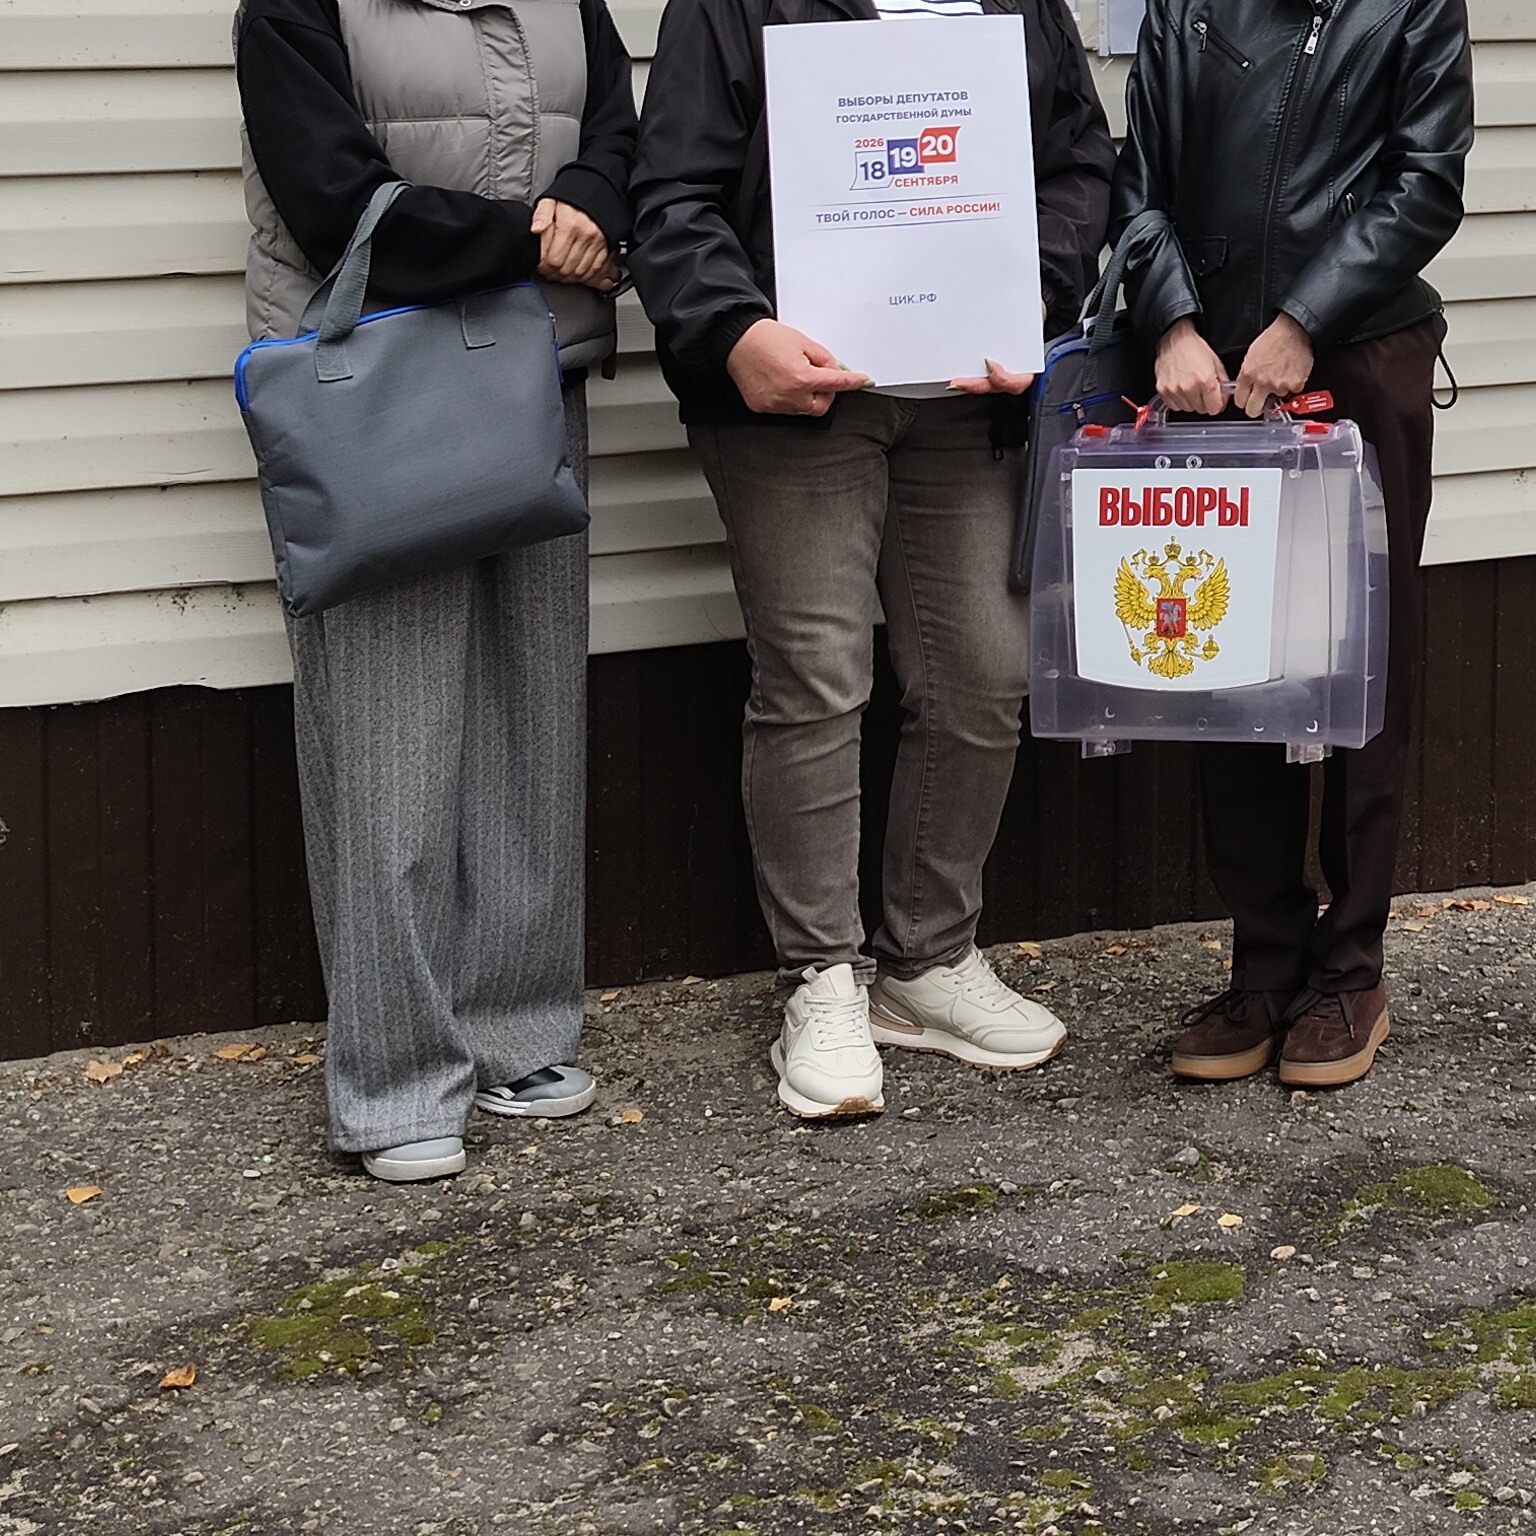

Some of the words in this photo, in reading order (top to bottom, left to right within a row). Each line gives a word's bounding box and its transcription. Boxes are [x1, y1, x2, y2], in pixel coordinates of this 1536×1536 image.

[838, 95, 893, 107] ВЫБОРЫ
[896, 91, 969, 105] ДЕПУТАТОВ
[836, 108, 938, 123] ГОСУДАРСТВЕННОЙ
[940, 108, 972, 118] ДУМЫ
[855, 138, 884, 148] 2026
[860, 161, 885, 181] 18
[889, 146, 917, 168] 19
[921, 135, 953, 156] 20
[894, 175, 958, 187] СЕНТЯБРЯ
[815, 210, 850, 223] ТВОЙ
[853, 209, 895, 221] ГОЛОС
[909, 206, 943, 217] СИЛА
[946, 202, 1000, 214] РОССИИ!
[889, 293, 937, 306] ЦИК.РФ
[1099, 486, 1250, 528] ВЫБОРЫ
